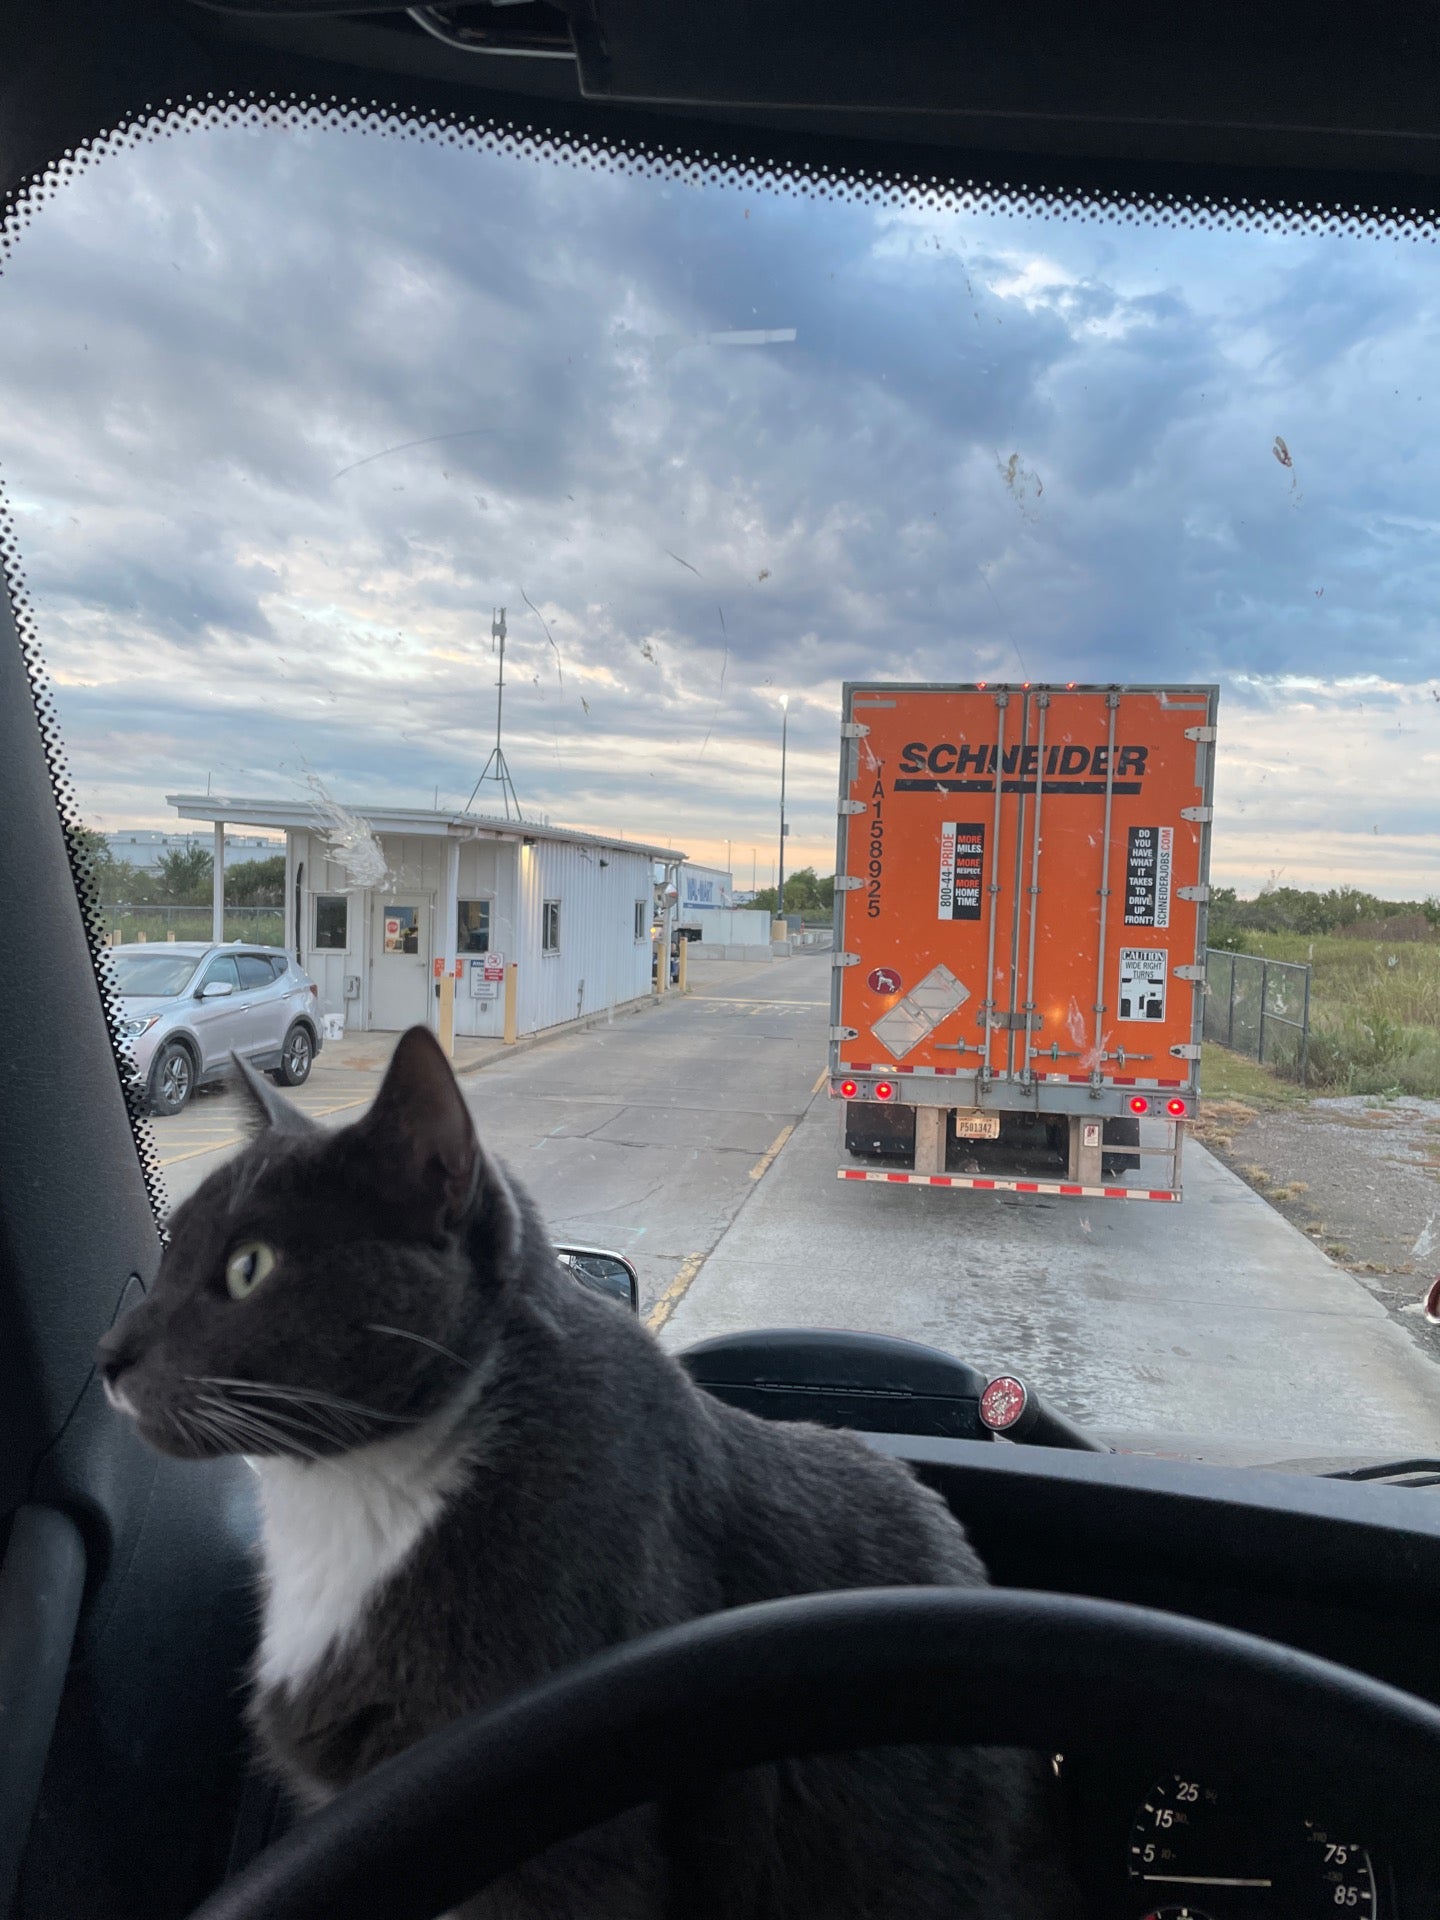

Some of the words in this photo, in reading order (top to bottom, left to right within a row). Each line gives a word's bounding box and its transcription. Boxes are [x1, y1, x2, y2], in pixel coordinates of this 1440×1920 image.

[899, 742, 1148, 776] SCHNEIDER
[1138, 829, 1150, 838] DO
[957, 835, 982, 844] MORE
[1135, 839, 1151, 848] YOU
[957, 844, 983, 853] MILES.
[1132, 849, 1153, 858] HAVE
[957, 858, 980, 867] MORE
[1130, 858, 1153, 867] WHAT
[940, 833, 954, 907] 800-44-PRIDE
[1137, 867, 1146, 876] IT
[1129, 877, 1153, 886] TAKES
[1157, 829, 1171, 926] SCHNEIDERJOBS.COM
[956, 879, 979, 888] MORE
[955, 888, 980, 897] HOME
[1136, 887, 1146, 896] TO
[957, 897, 979, 907] TIME.
[1134, 906, 1145, 915] UP
[1124, 915, 1154, 925] FRONT?
[1123, 951, 1164, 961] CAUTION
[1125, 961, 1141, 970] WIDE
[1143, 962, 1162, 971] RIGHT
[1133, 970, 1154, 979] TURNS
[1176, 1782, 1199, 1802] 25
[1155, 1809, 1174, 1828] 15
[1143, 1843, 1155, 1863] 5
[1323, 1843, 1347, 1865] 75
[1334, 1885, 1358, 1906] 85
